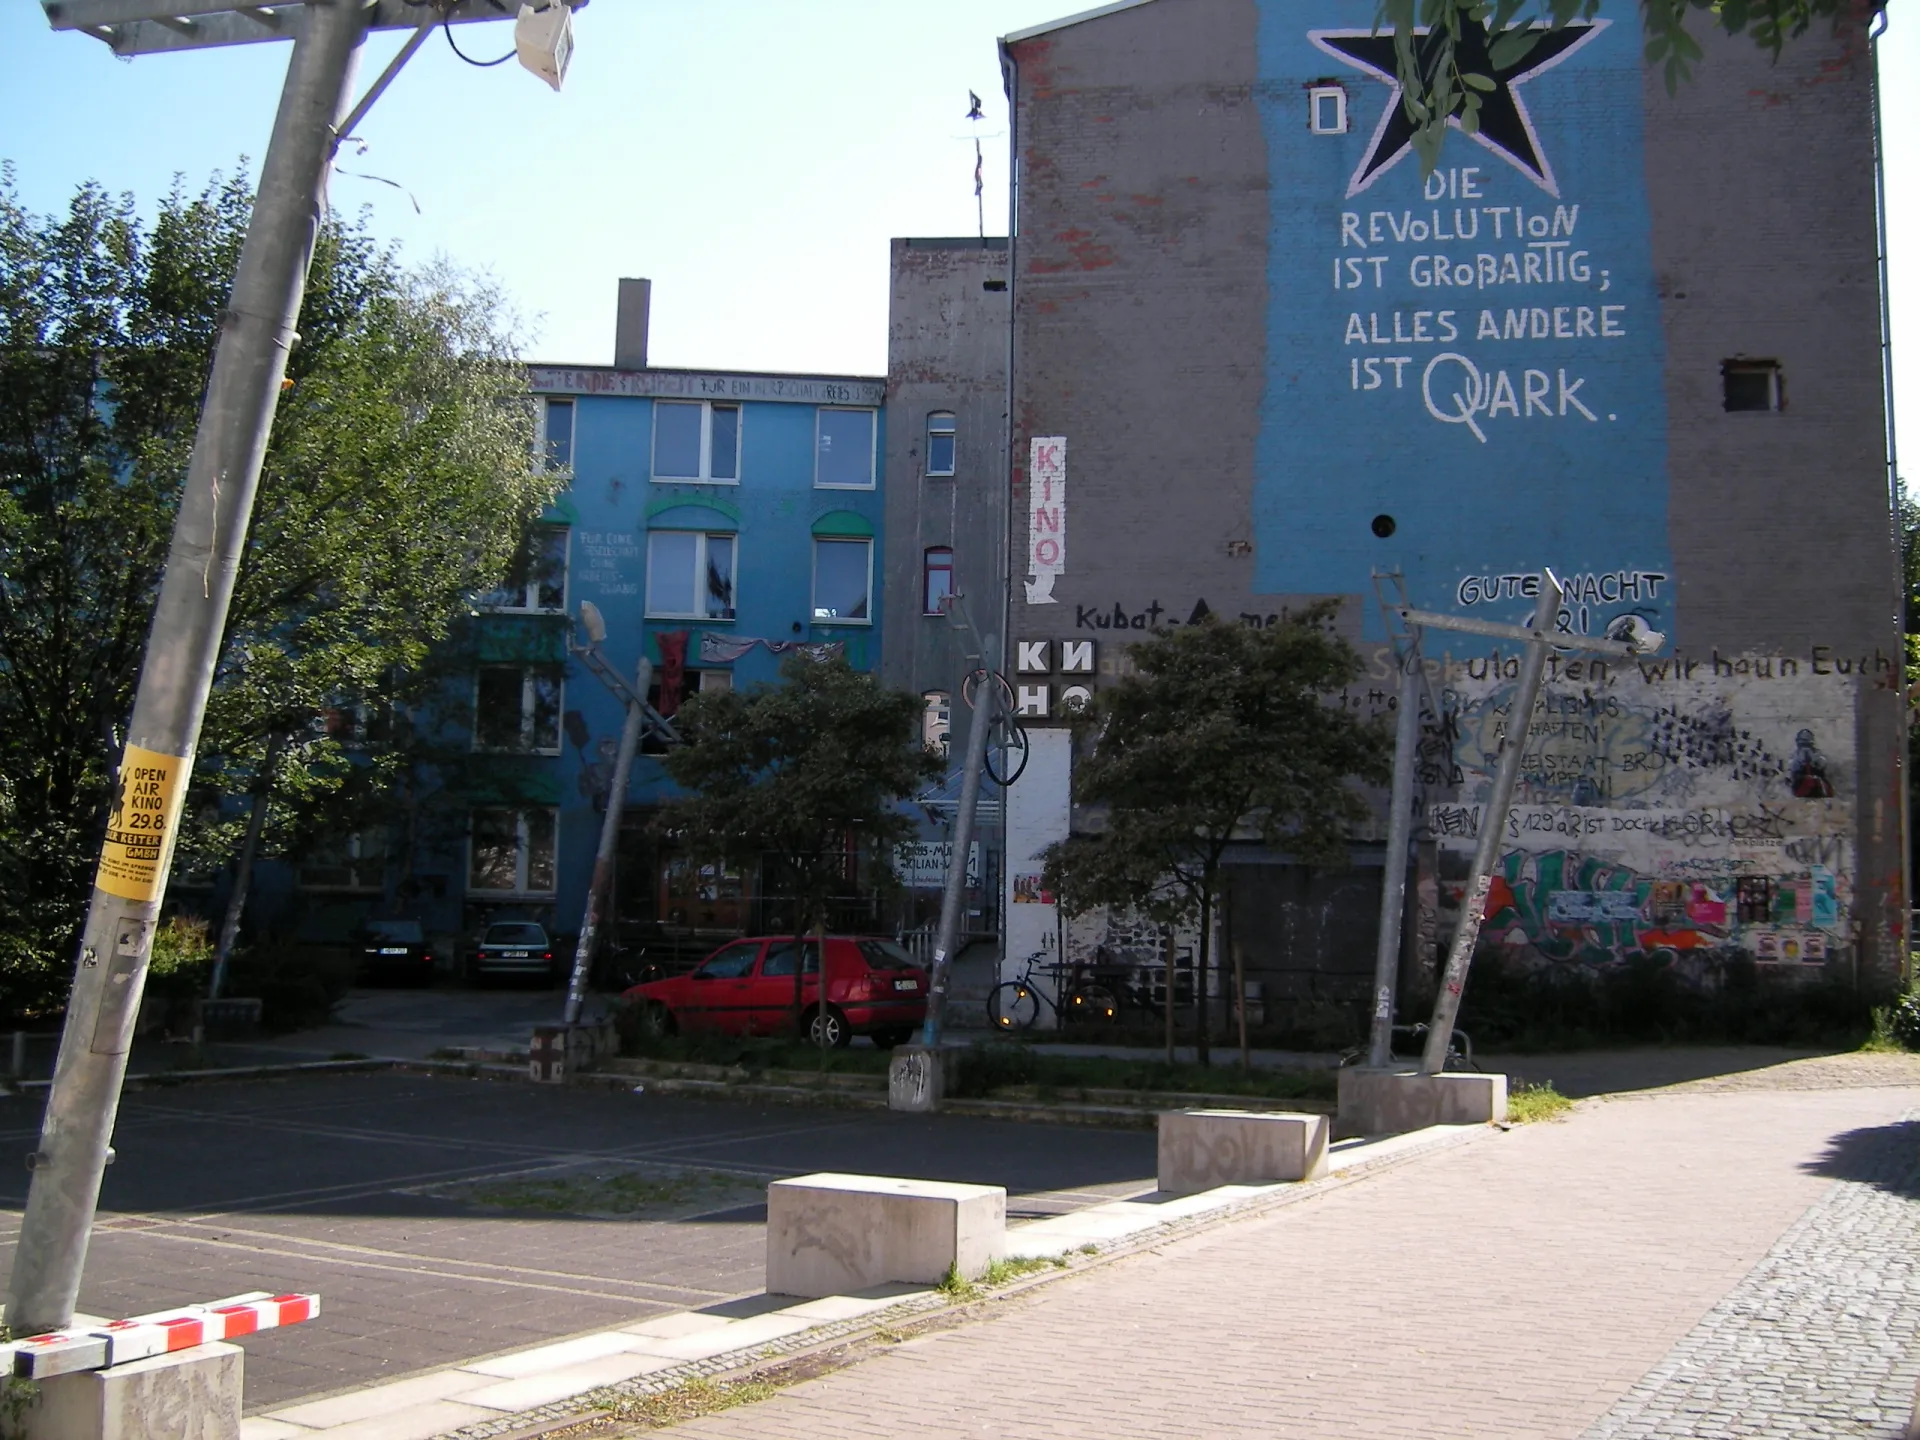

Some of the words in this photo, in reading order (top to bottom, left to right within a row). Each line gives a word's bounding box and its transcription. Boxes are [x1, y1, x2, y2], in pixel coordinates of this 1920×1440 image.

[1424, 167, 1483, 200] DIE
[1334, 256, 1389, 289] IST
[1345, 310, 1458, 345] ALLES
[1477, 305, 1627, 340] ANDERE
[1350, 356, 1413, 390] IST
[1035, 445, 1060, 566] KINO
[1458, 574, 1541, 606] GUTE
[1561, 571, 1667, 605] NACHT
[1637, 648, 1700, 685] wir
[1811, 645, 1891, 676] Euch
[133, 782, 160, 796] AIR
[134, 767, 167, 782] OPEN
[131, 795, 163, 810] KINO
[130, 812, 167, 830] 29.8.
[120, 832, 160, 846] REITER
[126, 847, 158, 859] GMBH
